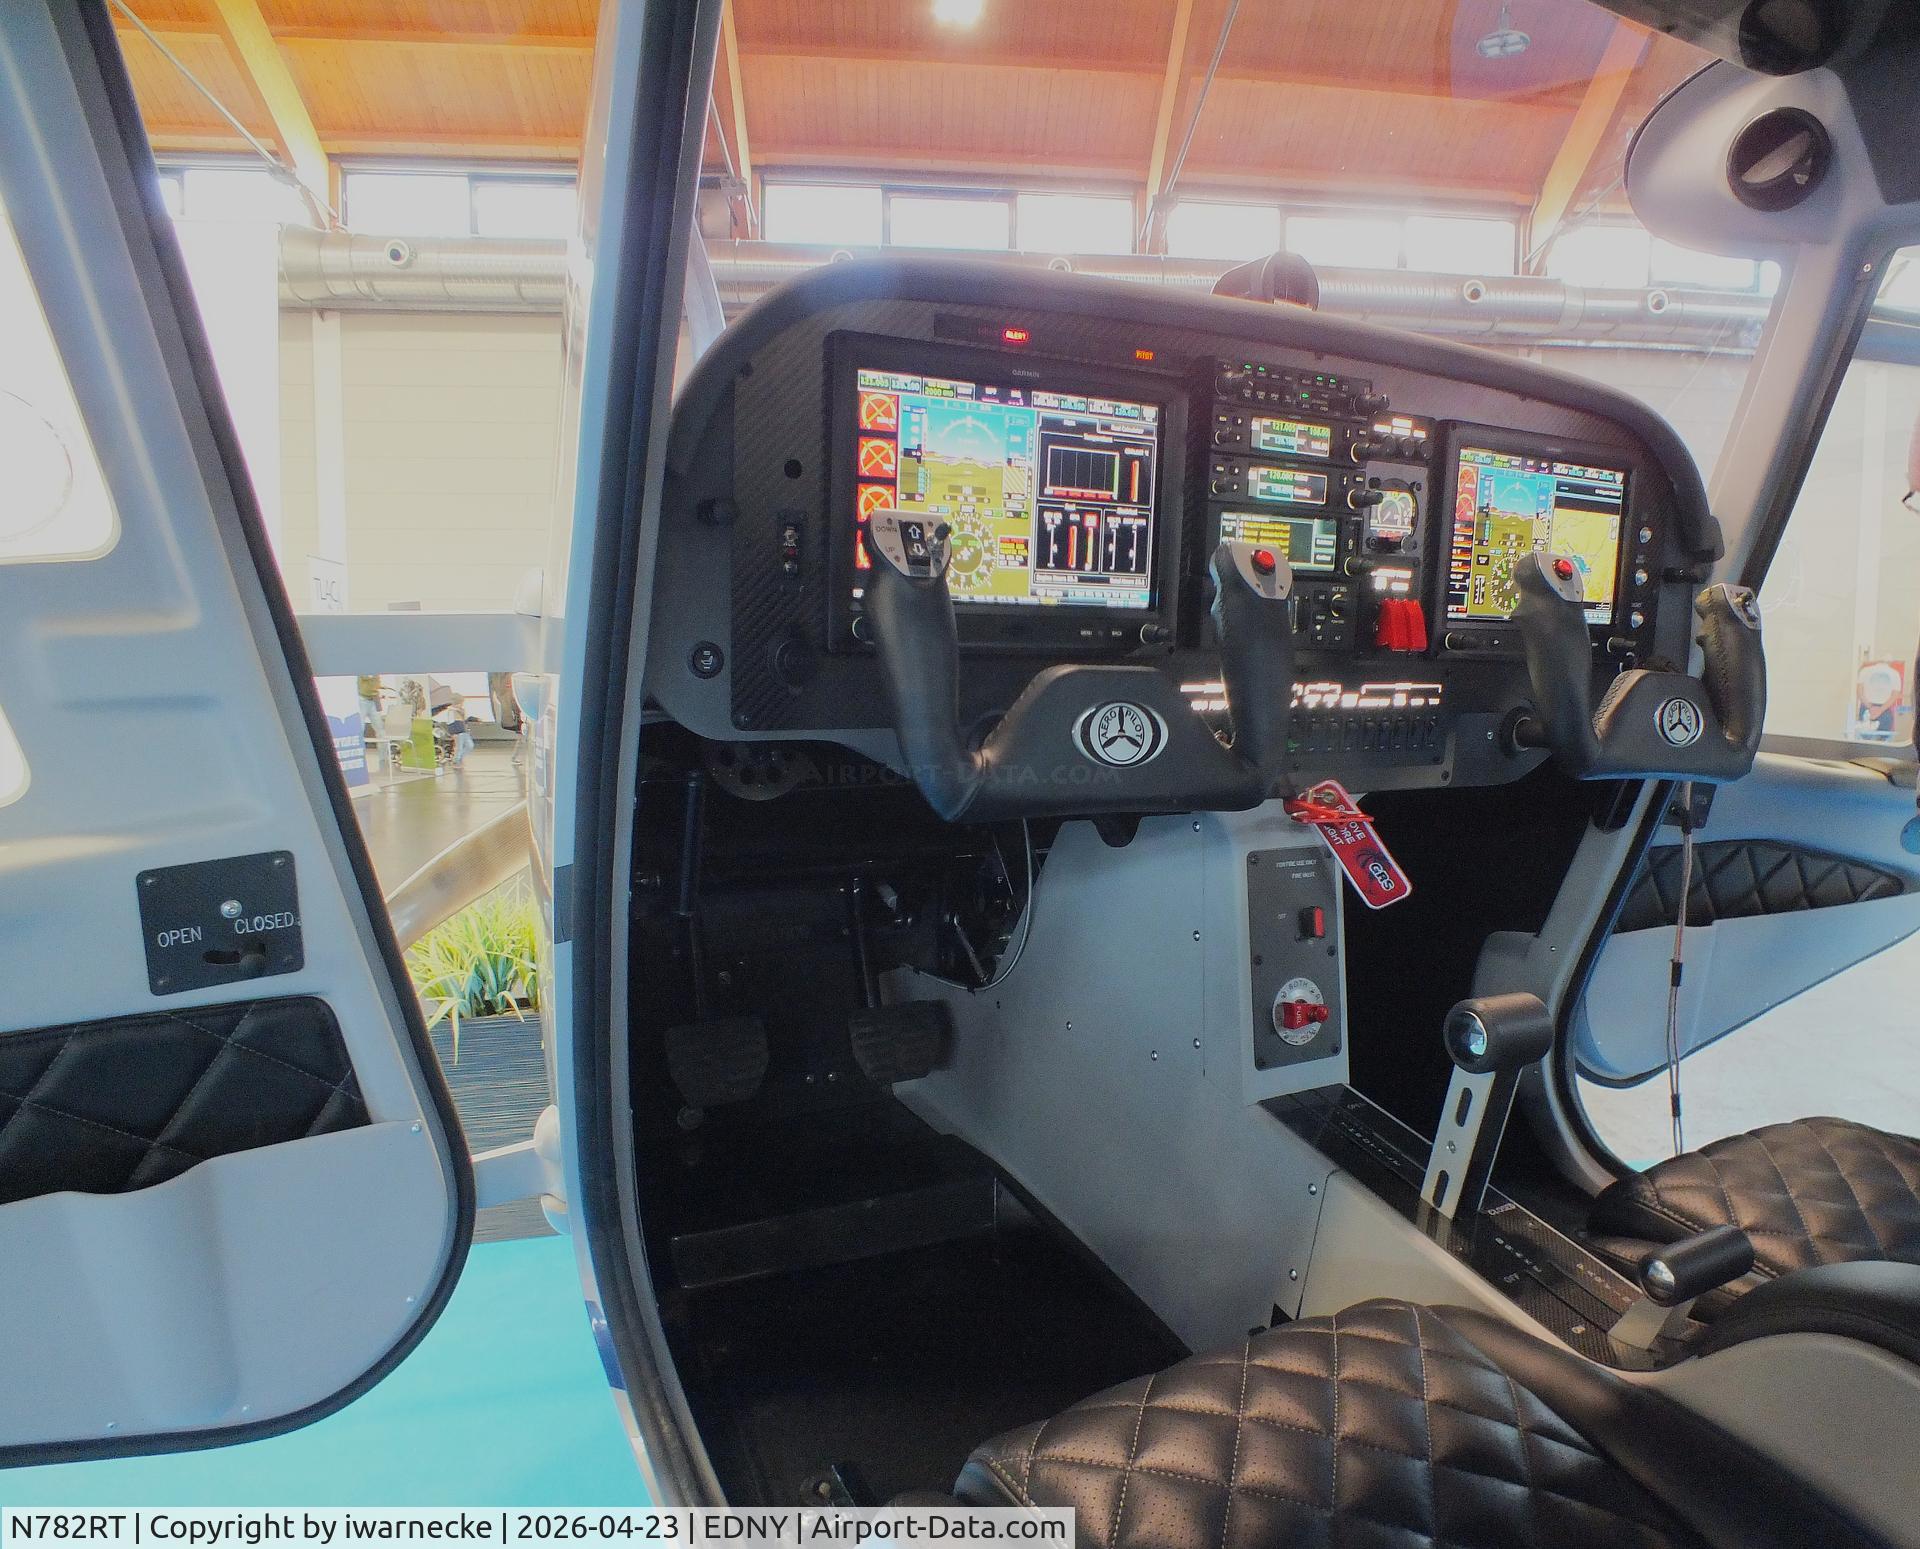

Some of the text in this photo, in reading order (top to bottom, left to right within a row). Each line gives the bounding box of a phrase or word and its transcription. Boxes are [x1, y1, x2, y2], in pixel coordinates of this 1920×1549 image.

[1011, 368, 1041, 379] GARMIN
[1100, 709, 1144, 740] AERO PILOT
[1368, 862, 1395, 891] GRS
[157, 912, 295, 947] OPEN CLOSED
